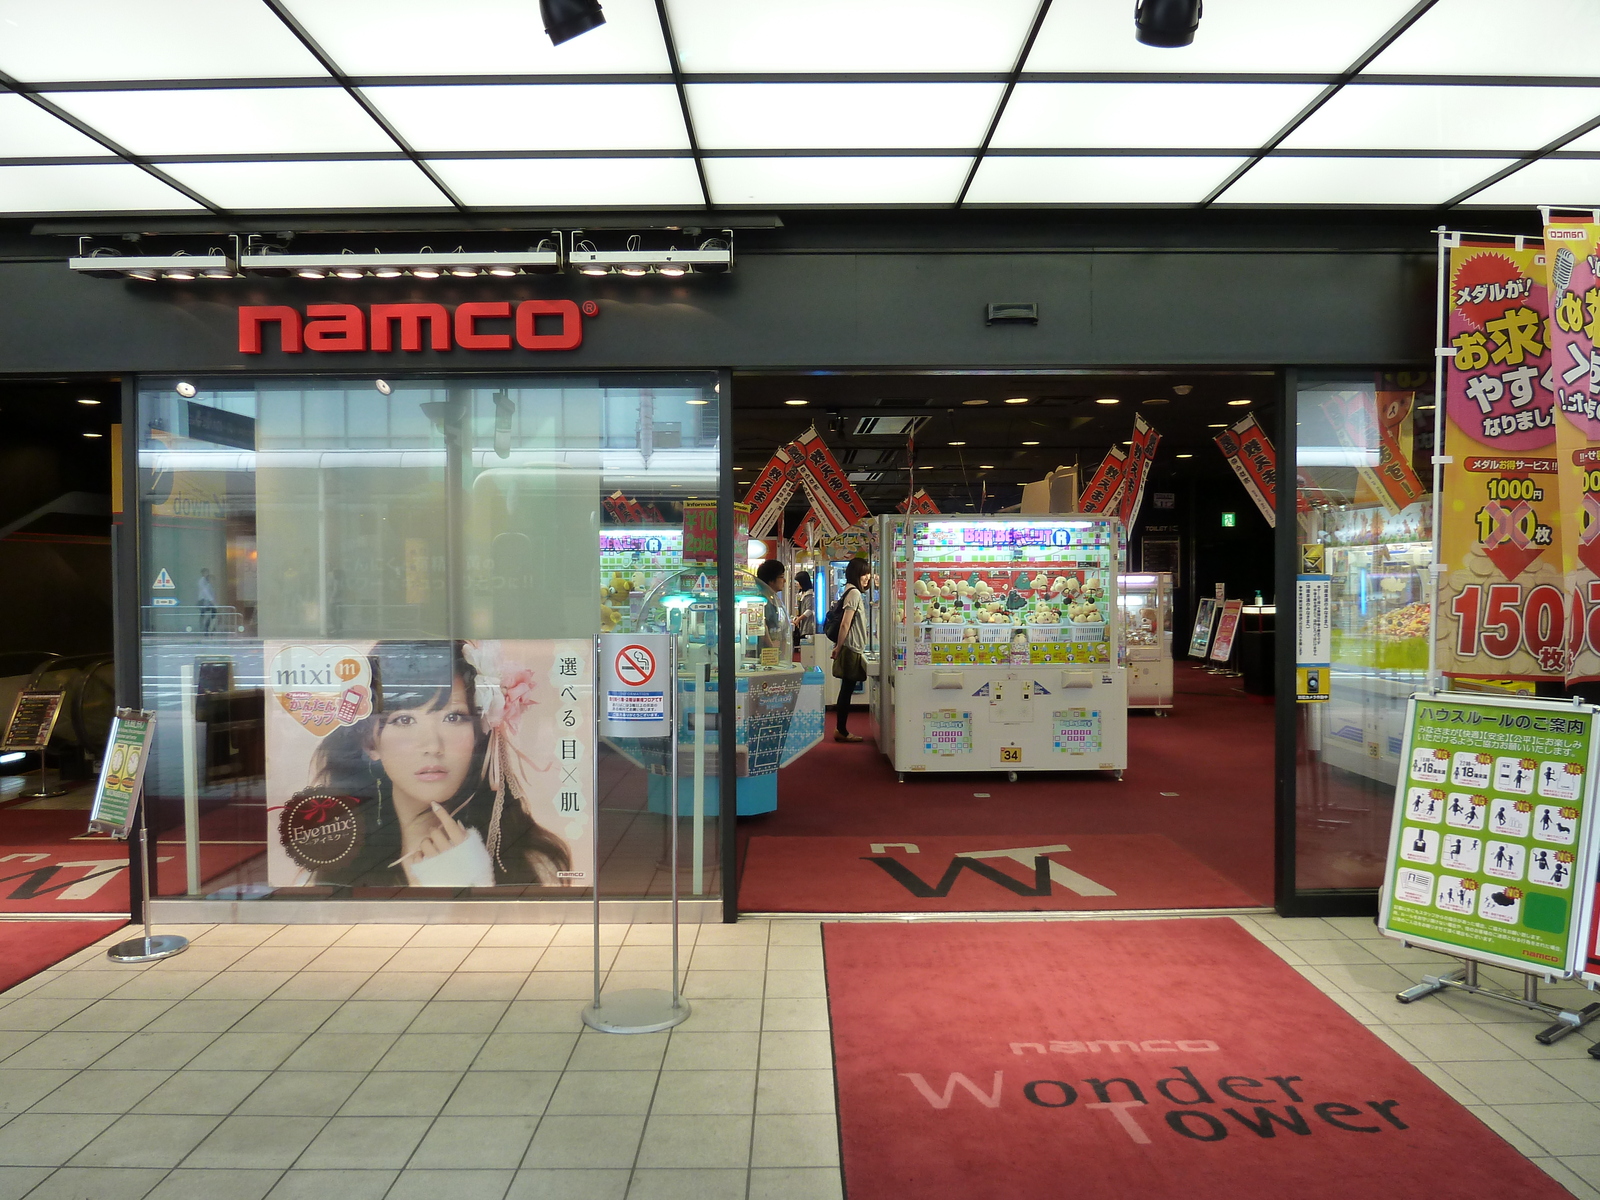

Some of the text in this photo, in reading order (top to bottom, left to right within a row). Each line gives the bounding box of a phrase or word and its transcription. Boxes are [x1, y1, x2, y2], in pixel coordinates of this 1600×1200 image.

[1488, 479, 1543, 500] 1000円
[686, 510, 717, 531] ¥10
[277, 664, 332, 685] mixi
[1420, 706, 1585, 735] ハウスルールのご案内
[1003, 750, 1019, 760] 34
[293, 817, 352, 843] Eyemix
[1522, 949, 1560, 963] namco
[1010, 1039, 1220, 1055] namco
[900, 1066, 1305, 1109] Wonder
[1085, 1098, 1410, 1145] Tower
